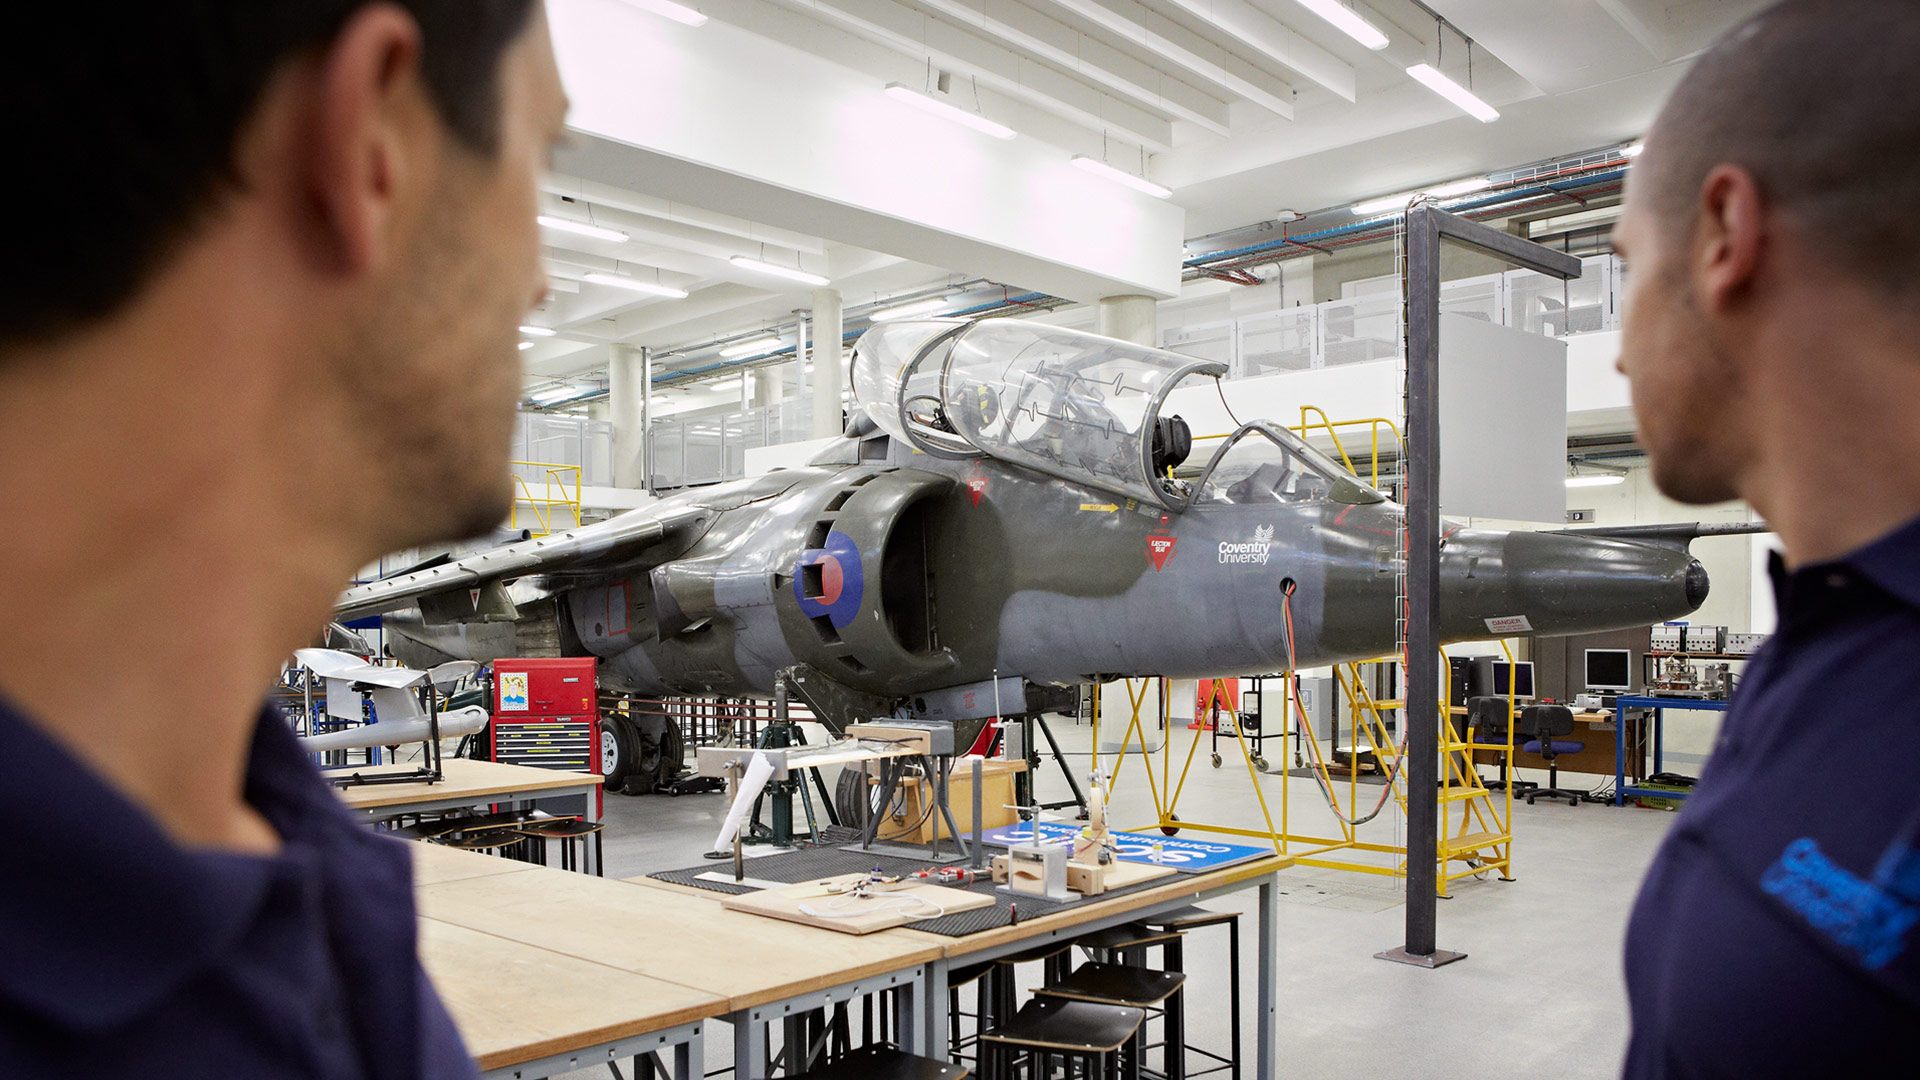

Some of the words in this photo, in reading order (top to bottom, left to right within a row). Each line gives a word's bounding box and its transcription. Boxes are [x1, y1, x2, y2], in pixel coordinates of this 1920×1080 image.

[1218, 541, 1271, 555] Coventry
[1218, 553, 1270, 565] University
[1491, 618, 1522, 626] DANGER
[582, 701, 589, 710] 3
